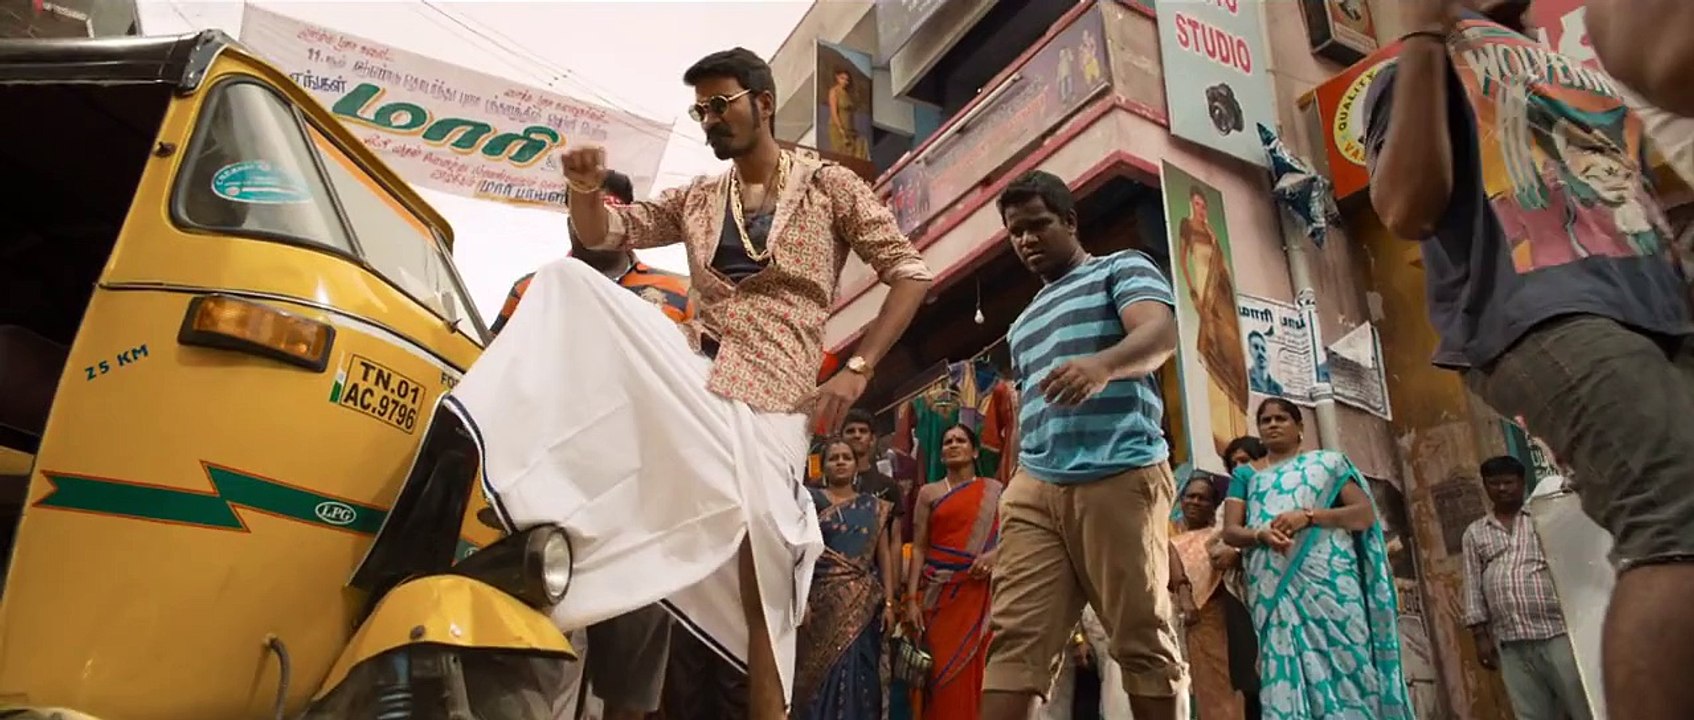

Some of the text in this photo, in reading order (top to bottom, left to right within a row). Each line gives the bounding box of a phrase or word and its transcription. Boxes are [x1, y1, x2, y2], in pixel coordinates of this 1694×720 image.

[1176, 13, 1251, 73] STUDIO
[289, 69, 348, 94] எங்கள்
[1338, 67, 1376, 131] QUALITY
[331, 82, 562, 164] மாரி
[117, 344, 149, 366] KM
[360, 361, 419, 404] TN.01
[343, 382, 416, 430] AC.9796
[321, 504, 351, 520] LPG
